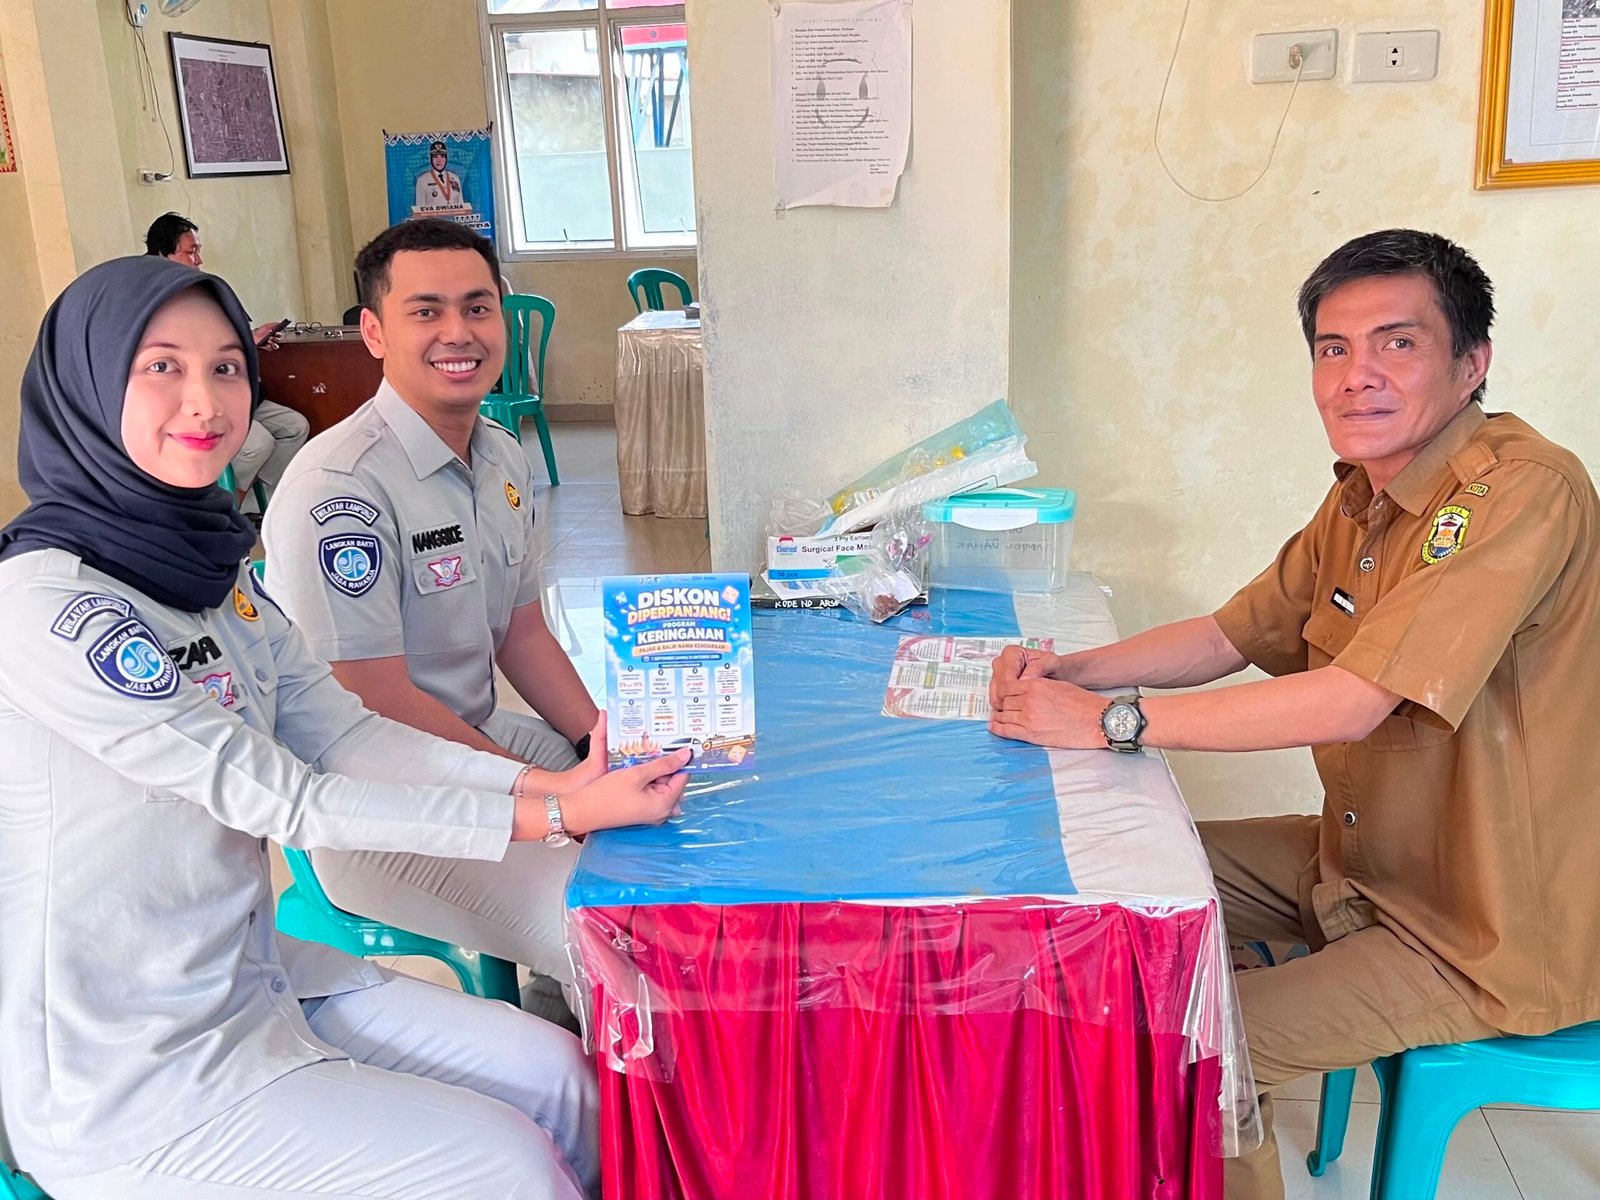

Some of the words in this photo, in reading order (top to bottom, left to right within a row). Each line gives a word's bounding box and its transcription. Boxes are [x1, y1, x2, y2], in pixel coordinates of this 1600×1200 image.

[1470, 485, 1486, 494] KOTA
[317, 502, 344, 518] WILAYAH
[345, 502, 373, 519] LAMPUNG
[325, 540, 355, 551] LANGKAH
[356, 540, 375, 548] BAKTI
[801, 545, 834, 553] Surgical
[835, 544, 855, 552] Face
[331, 572, 347, 587] JASA
[637, 587, 720, 609] DISKON
[775, 600, 798, 608] KODE
[60, 601, 90, 632] WILAYAH
[627, 605, 731, 625] DIPERPANJANG!
[637, 628, 724, 645] KERINGANAN
[96, 633, 129, 662] LANGKAH
[125, 681, 153, 692] JASA
